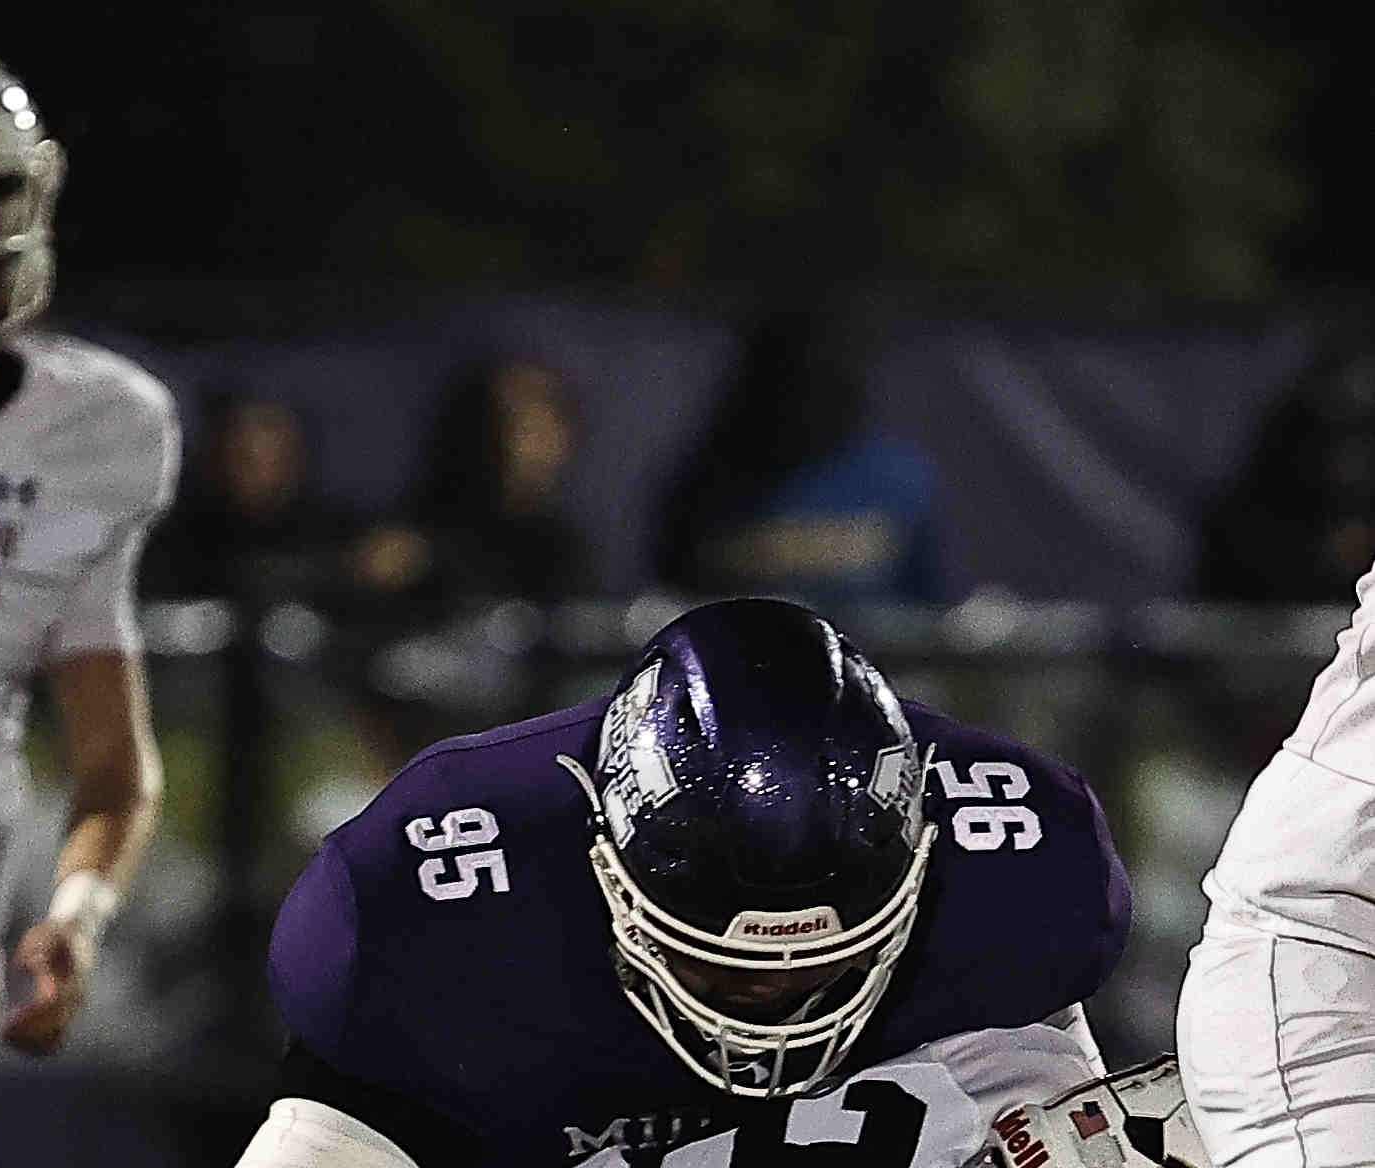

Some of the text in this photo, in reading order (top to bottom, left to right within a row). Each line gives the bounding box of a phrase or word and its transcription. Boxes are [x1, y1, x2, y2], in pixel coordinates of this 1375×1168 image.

[936, 761, 1043, 851] 95
[406, 807, 511, 900] 95
[743, 915, 829, 936] Riddell
